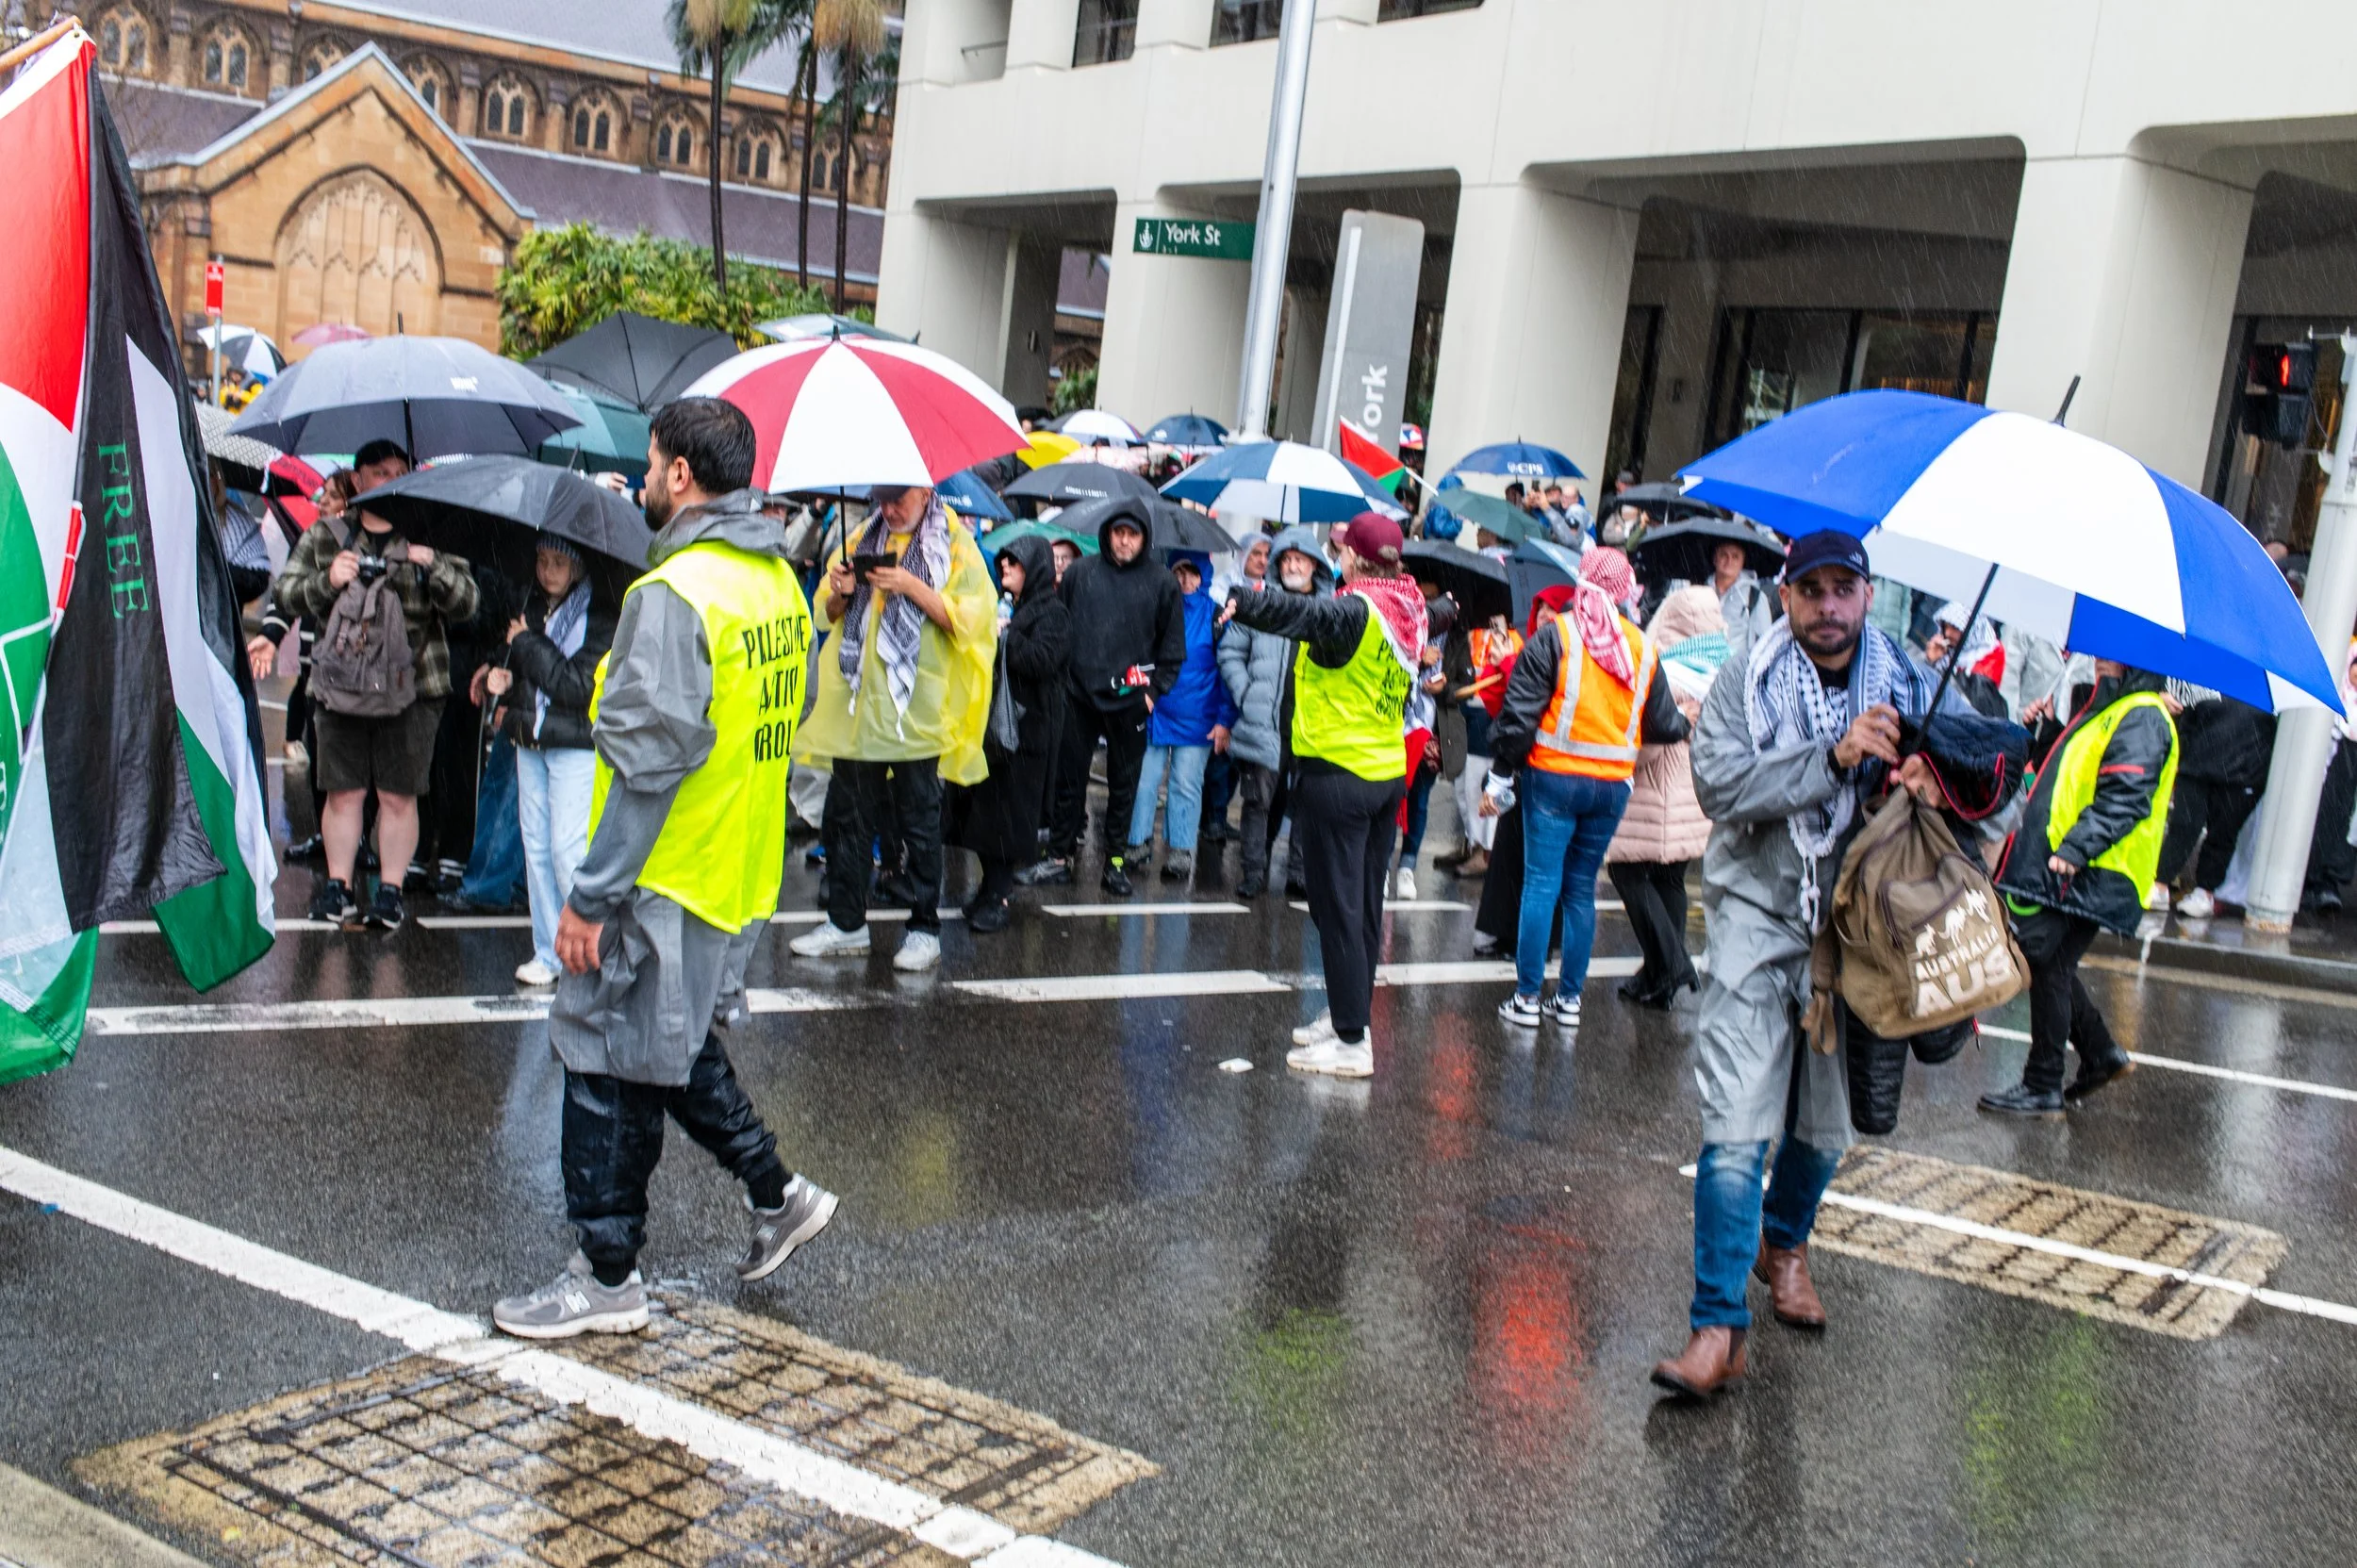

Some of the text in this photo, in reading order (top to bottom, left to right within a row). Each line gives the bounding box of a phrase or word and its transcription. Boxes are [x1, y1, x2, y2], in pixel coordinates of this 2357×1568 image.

[1164, 222, 1222, 246] York St
[97, 437, 150, 619] FREE
[741, 615, 807, 669] PALESTE
[1915, 924, 2000, 982] AUSTRALIA
[1915, 943, 2012, 1017] AUS
